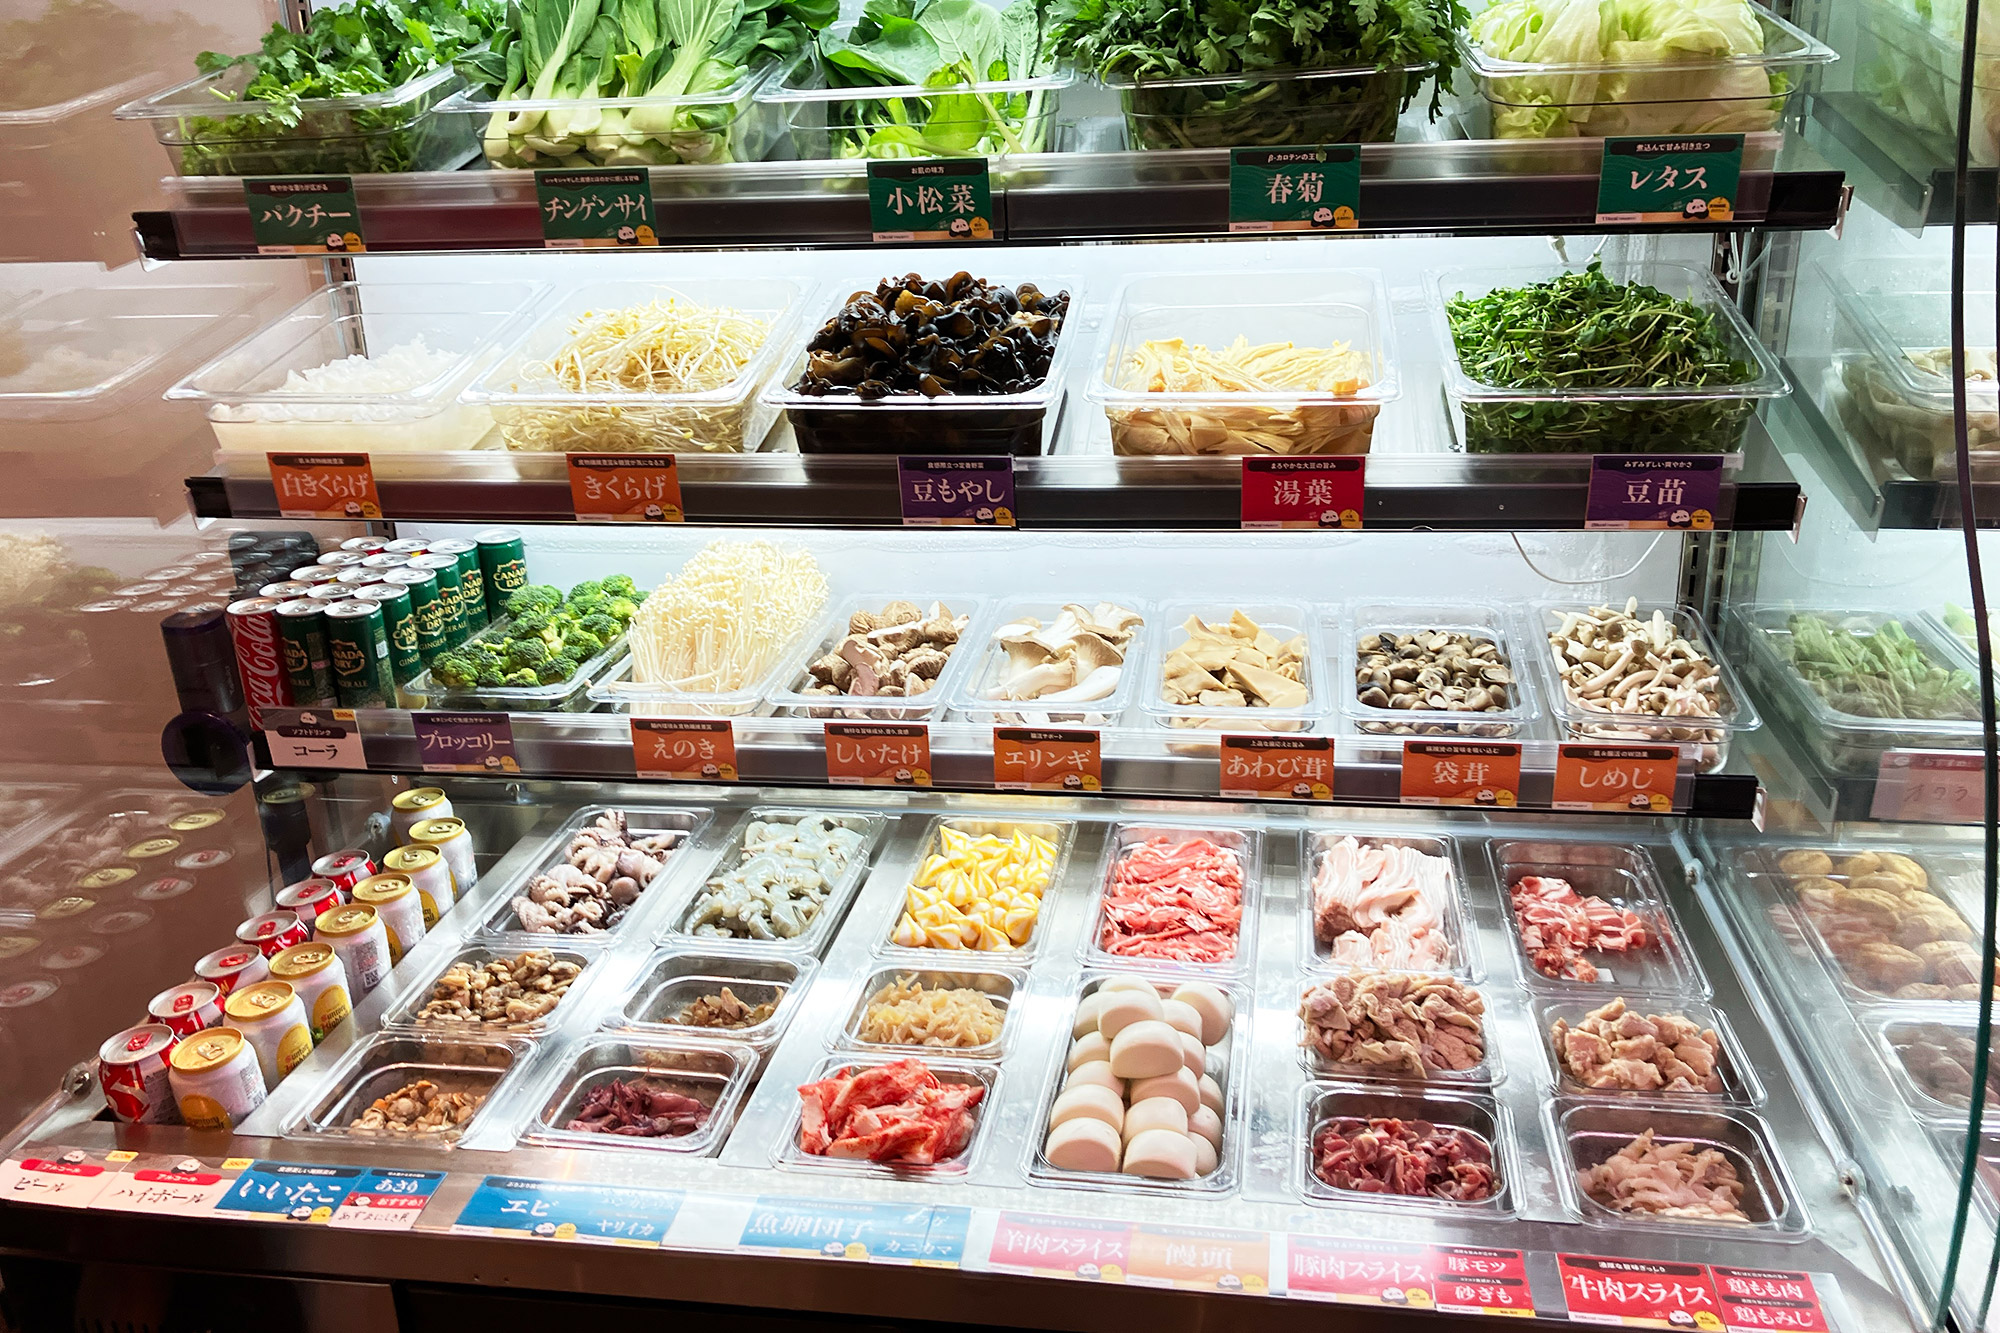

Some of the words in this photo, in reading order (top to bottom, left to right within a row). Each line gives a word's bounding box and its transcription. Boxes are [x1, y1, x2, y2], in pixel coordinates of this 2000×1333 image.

[1635, 142, 1711, 153] 煮込んで甘み引き立つ
[911, 166, 945, 175] お肌の味方
[1629, 165, 1708, 193] レタス
[885, 184, 978, 215] 小松菜
[1265, 173, 1326, 204] 春菊
[260, 202, 352, 229] パクチー
[543, 193, 648, 223] チンゲンサイ
[280, 472, 370, 498] 白きくらげ
[582, 473, 668, 501] きくらげ
[910, 477, 1006, 504] 豆もやし
[1273, 478, 1334, 506] 湯葉
[1621, 478, 1688, 506] 豆苗
[293, 744, 339, 761] コーラ
[420, 731, 512, 753] ブロッコリー
[652, 736, 716, 760] えのき
[834, 742, 922, 766] しいたけ
[1003, 748, 1091, 771] エリンギ
[1225, 754, 1328, 780] あわび茸
[1431, 760, 1490, 787] 袋茸
[1578, 766, 1654, 790] しめじ
[41, 1164, 81, 1174] アルコール
[155, 1173, 199, 1183] アルコール
[13, 1176, 69, 1194] ビール
[114, 1186, 212, 1204] ハイボール
[238, 1178, 342, 1204] いいたこ
[374, 1178, 420, 1194] あさり
[376, 1197, 424, 1208] おすすめ!
[500, 1198, 560, 1218] エビ
[596, 1219, 656, 1237] ヤリイカ
[1005, 1228, 1125, 1260] 羊肉スライス
[1293, 1253, 1427, 1285] 豚肉スライス
[1446, 1255, 1508, 1274] 豚モツ
[1454, 1285, 1514, 1305] 砂ぎも
[1567, 1273, 1714, 1307] 牛肉スライス
[1725, 1277, 1805, 1300] 鶏もも肉
[1731, 1304, 1815, 1328] 鶏もみじ
